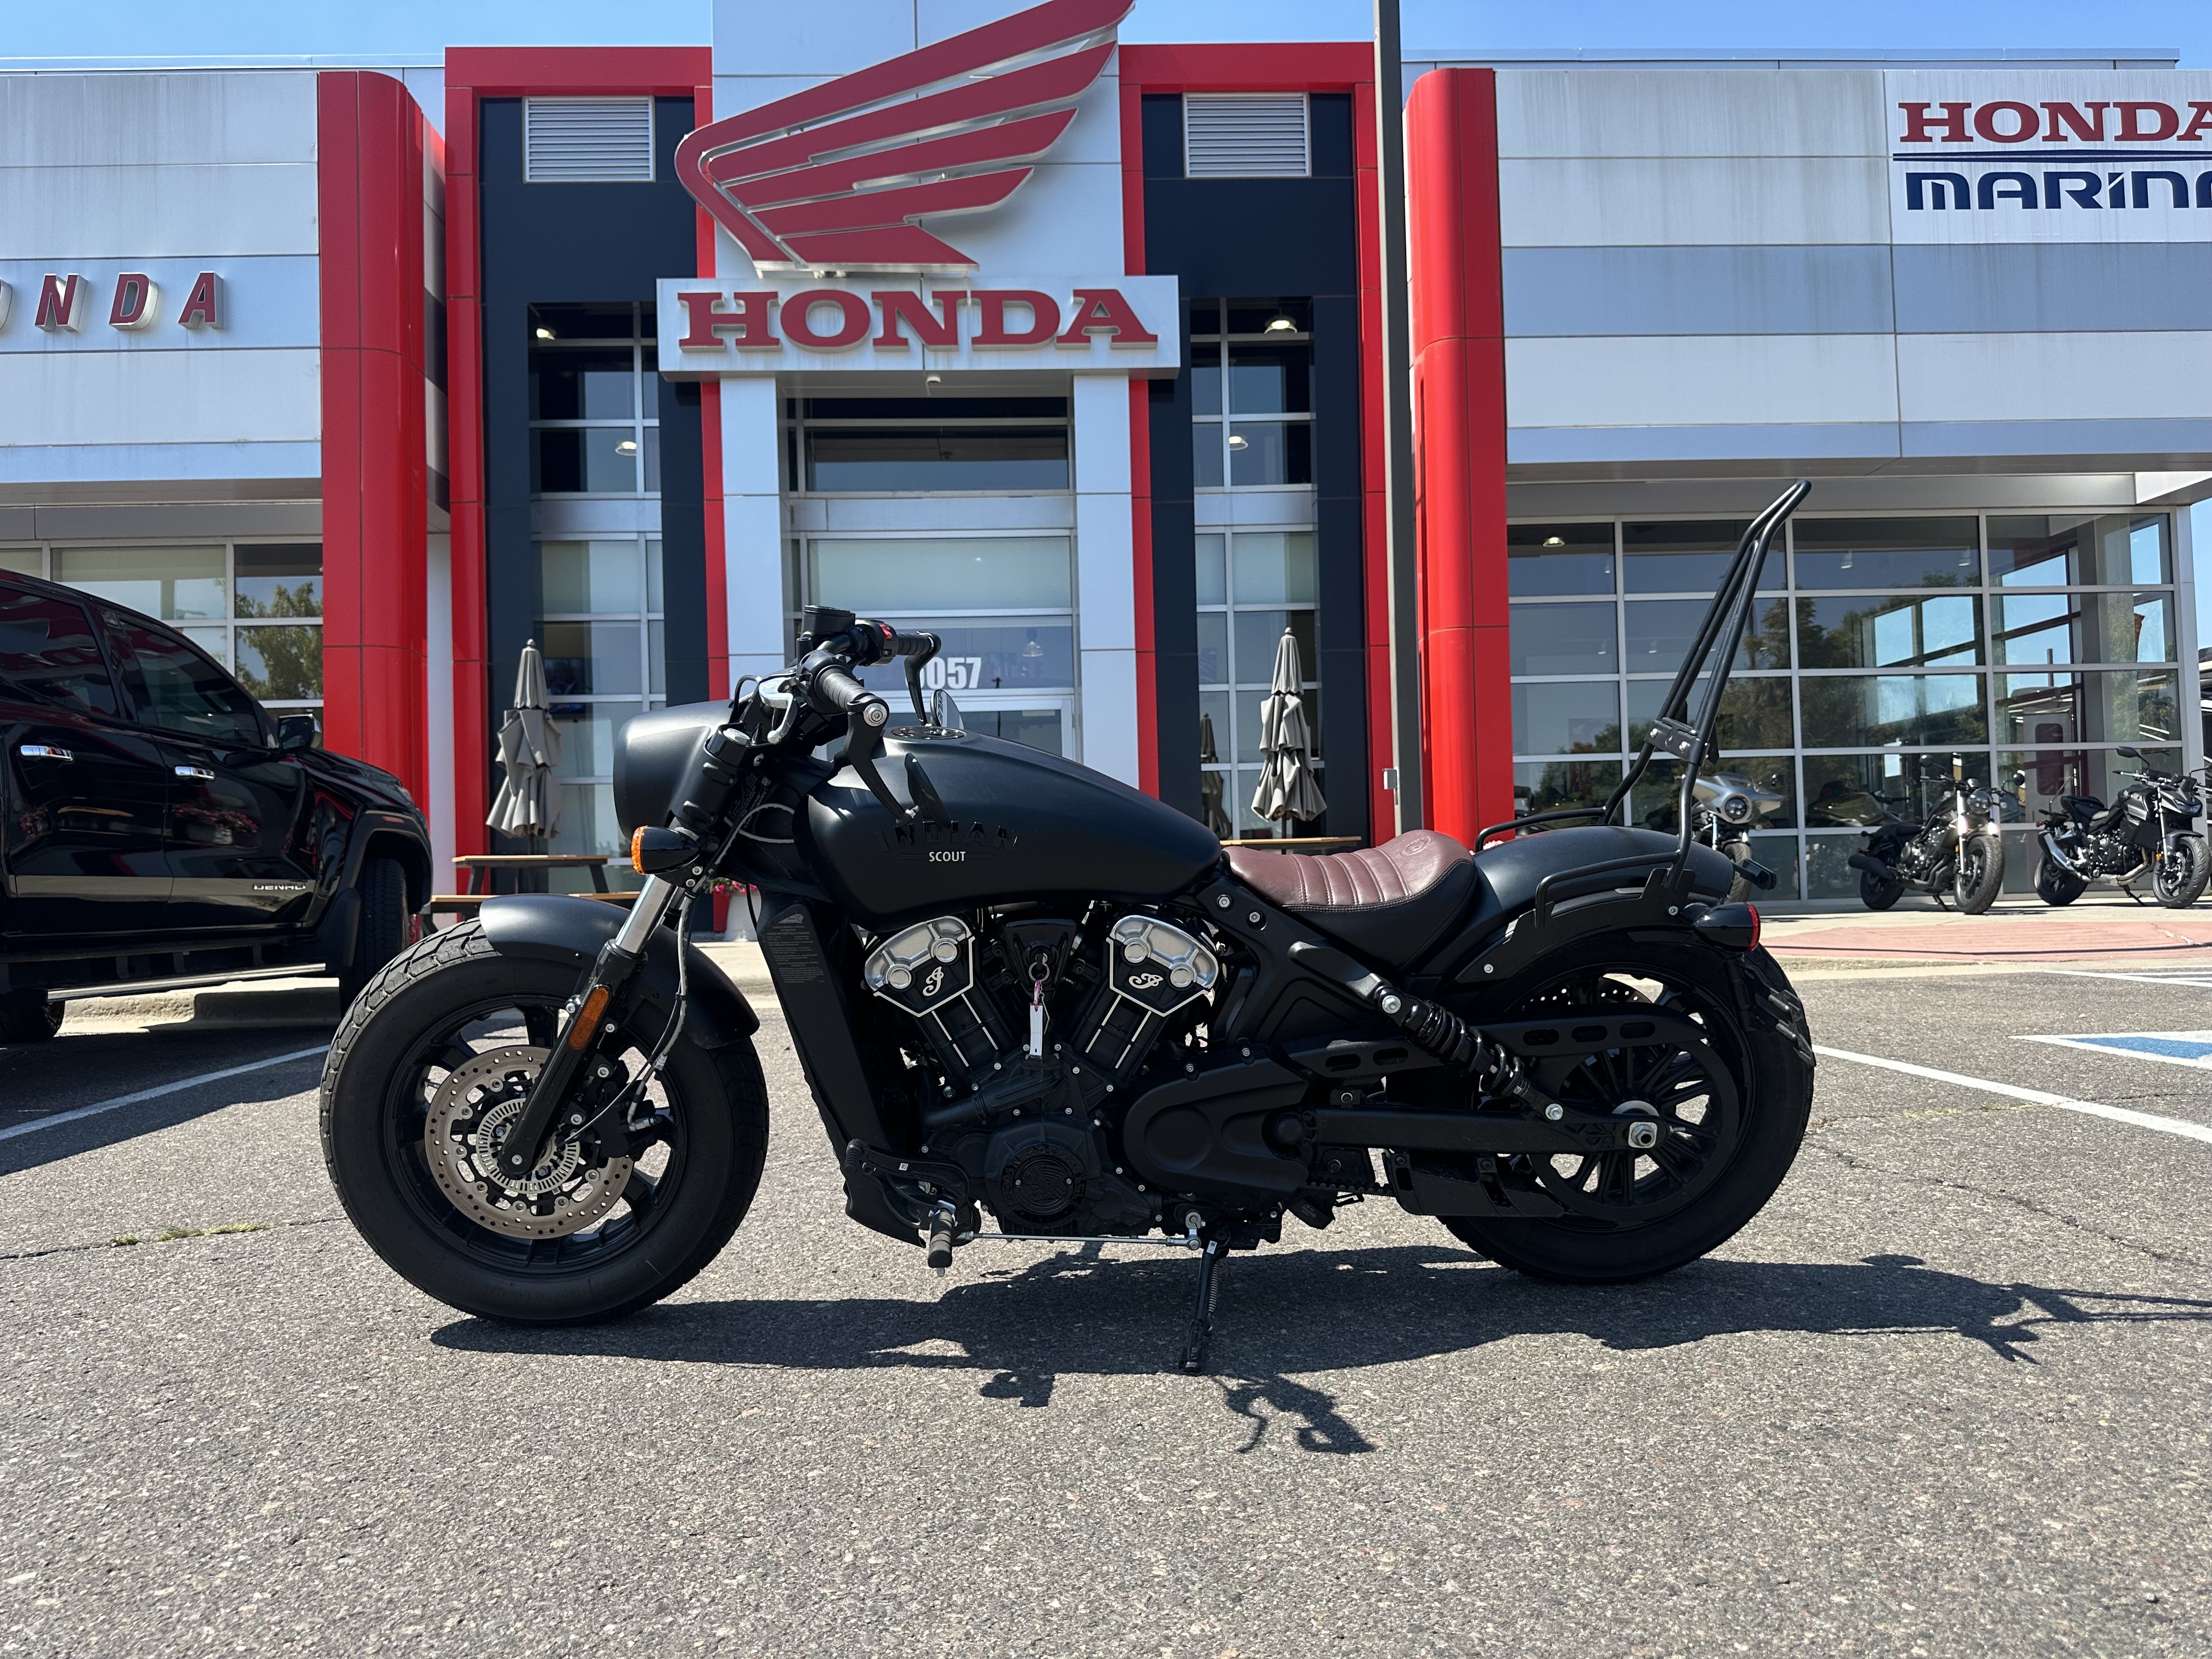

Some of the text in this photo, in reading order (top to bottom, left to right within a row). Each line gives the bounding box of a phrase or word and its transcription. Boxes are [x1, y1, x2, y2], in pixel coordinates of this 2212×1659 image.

[1905, 171, 2212, 210] MARIN
[0, 272, 225, 331] NDA
[678, 289, 1158, 354] HONDA
[874, 820, 1019, 853] INDIAN
[929, 851, 966, 862] SCOUT
